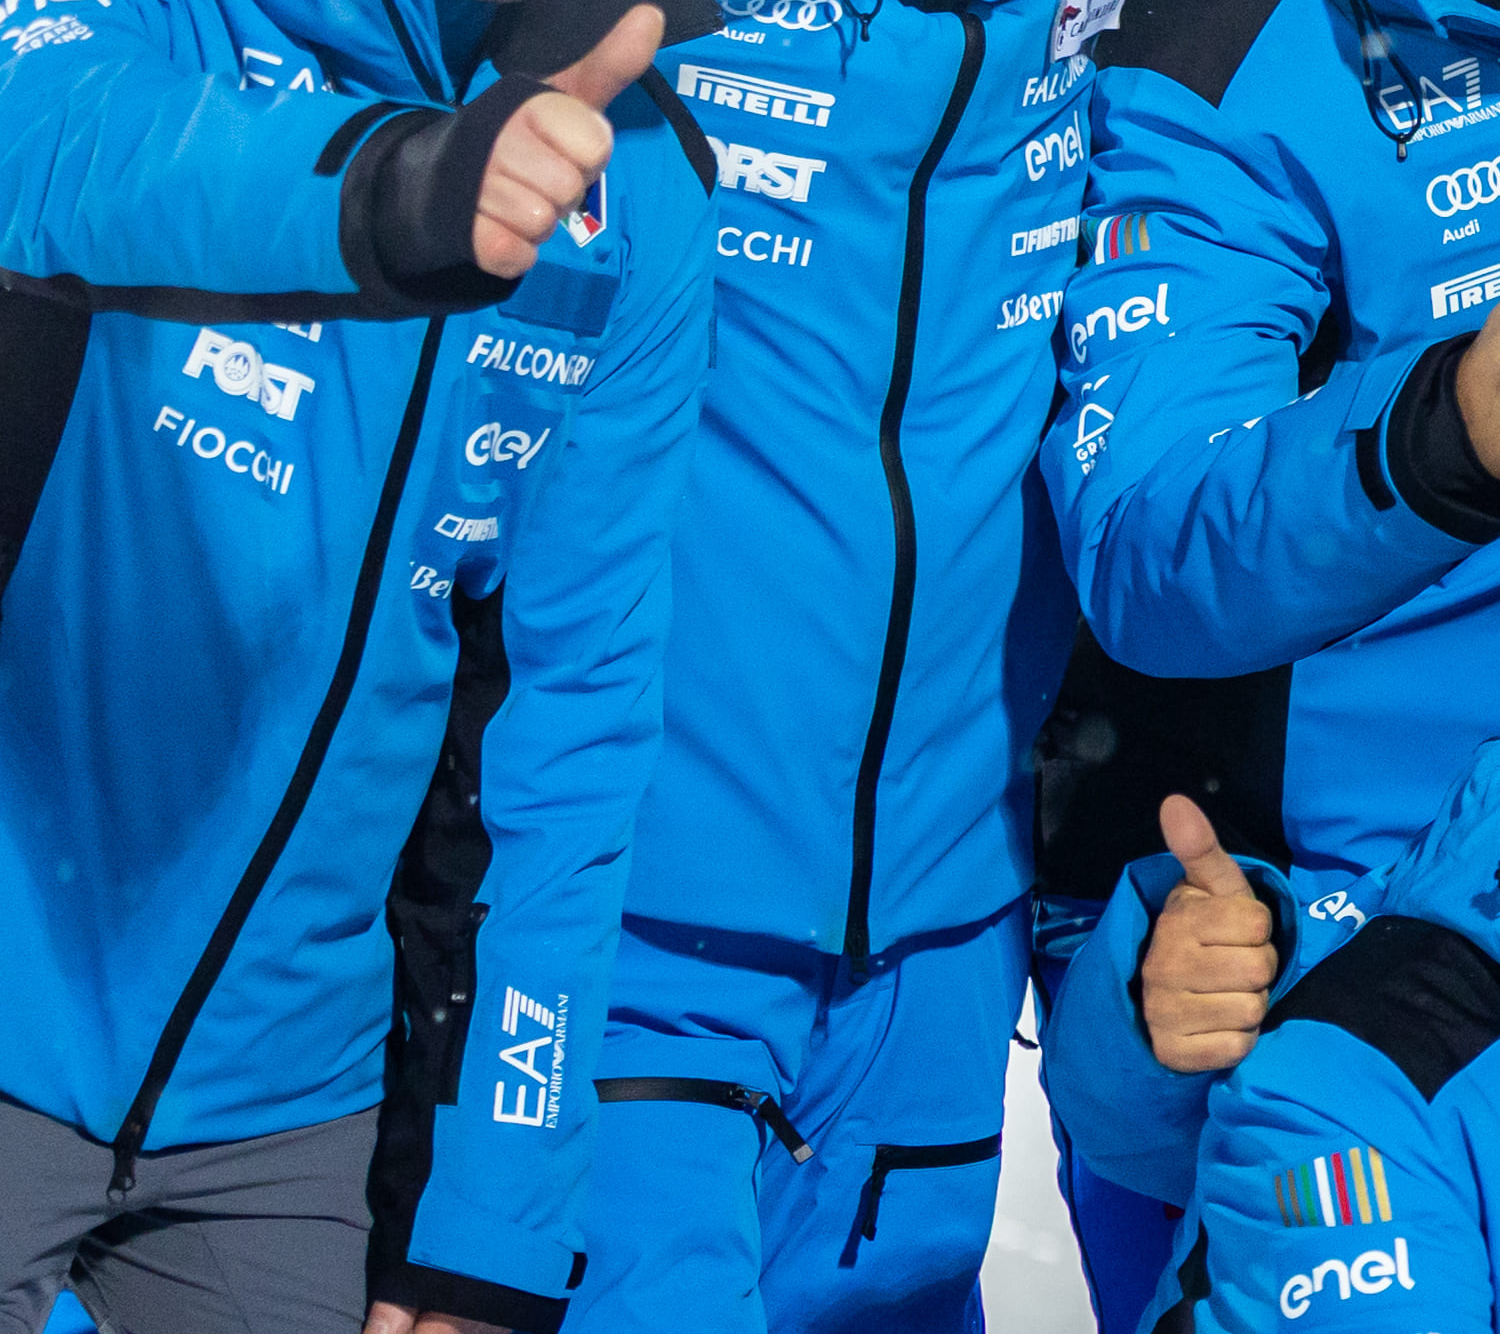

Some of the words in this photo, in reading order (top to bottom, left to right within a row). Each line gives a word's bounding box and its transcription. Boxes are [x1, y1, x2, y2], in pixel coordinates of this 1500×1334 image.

[716, 28, 765, 45] Audi
[676, 64, 836, 127] PIRELLI
[1379, 57, 1481, 130] EA7
[1025, 111, 1083, 181] enel
[1442, 219, 1480, 244] Audi
[1071, 283, 1170, 364] enel
[153, 406, 294, 495] FIOCCHI
[493, 986, 555, 1128] EA7
[545, 1060, 563, 1129] EMPORIO
[554, 994, 569, 1043] ARMANI
[1279, 1237, 1415, 1320] enel
